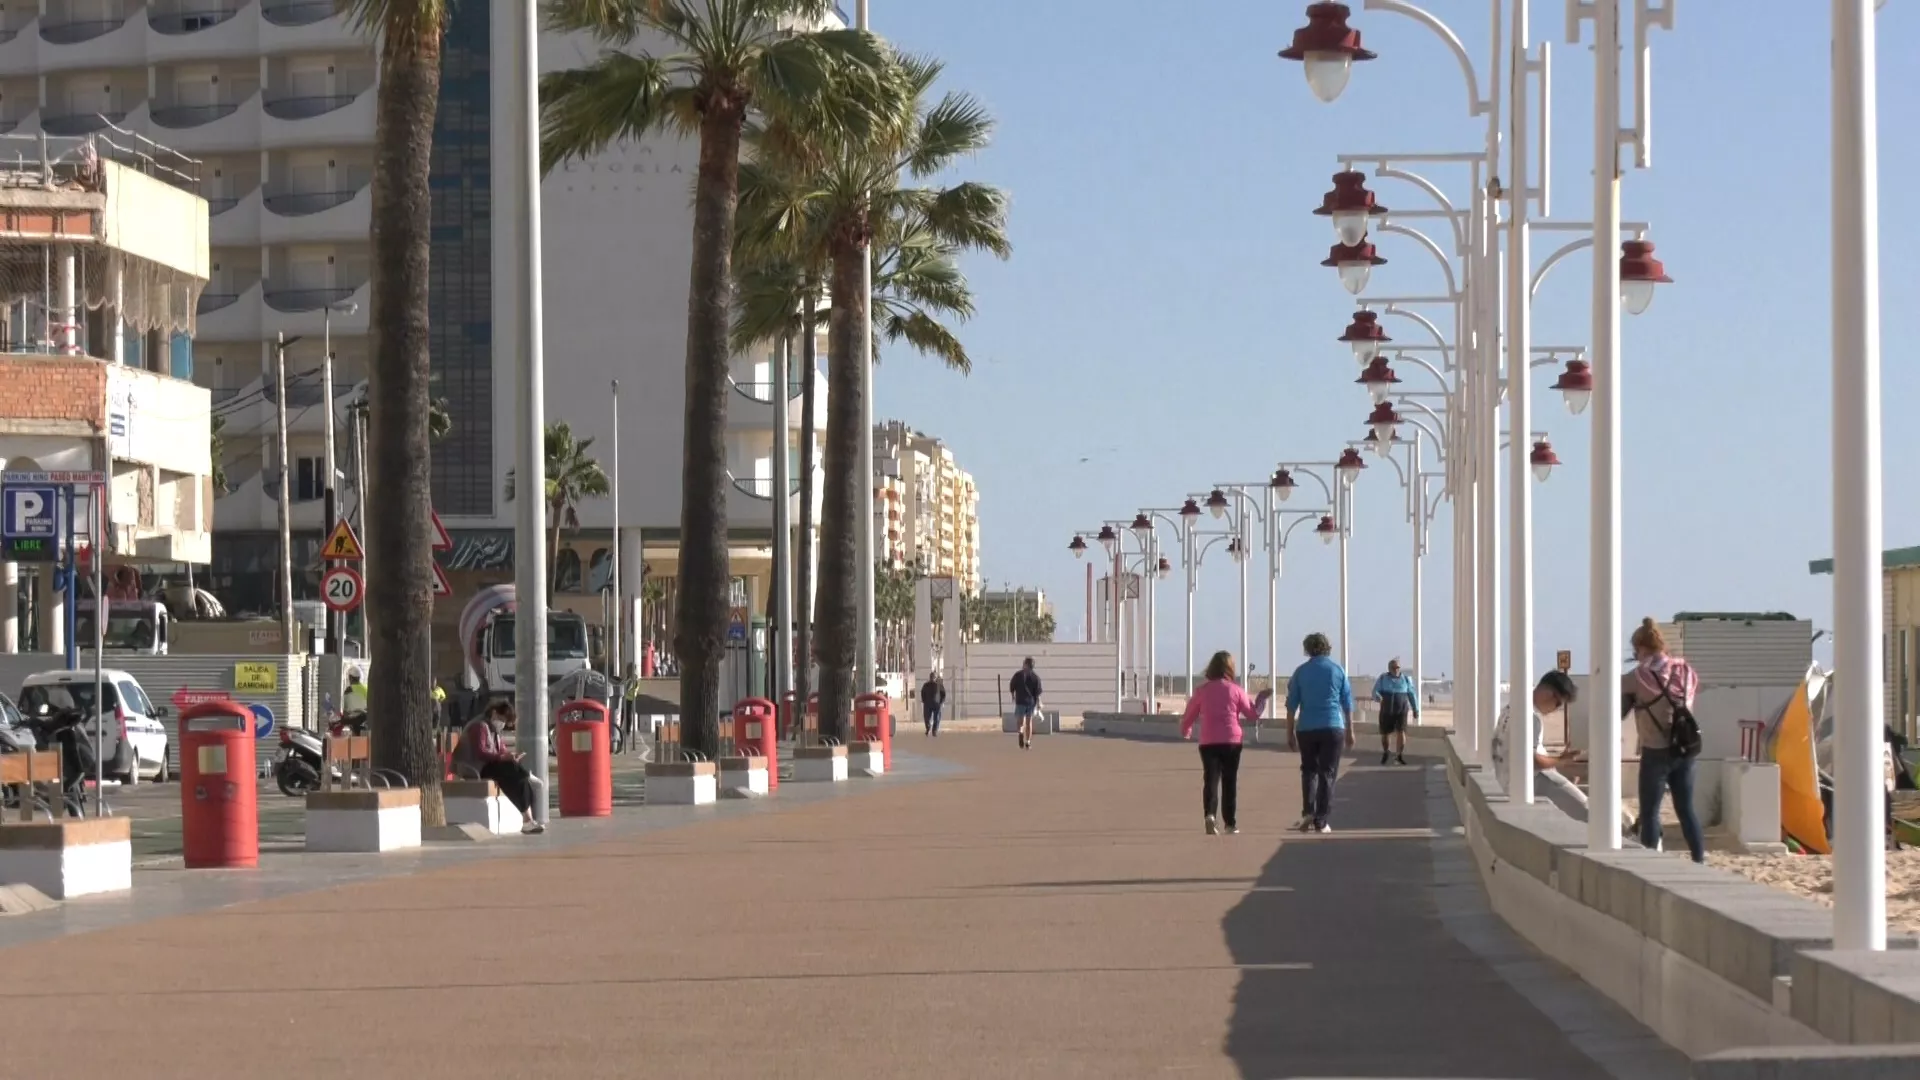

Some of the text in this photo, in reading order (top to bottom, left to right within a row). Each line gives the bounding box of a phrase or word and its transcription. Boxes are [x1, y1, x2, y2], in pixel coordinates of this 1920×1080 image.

[4, 471, 31, 481] PARKING
[50, 471, 71, 481] PASEO
[15, 491, 43, 532] P
[25, 518, 52, 526] PARKING
[328, 578, 353, 598] 20
[237, 682, 274, 690] CAMIONES
